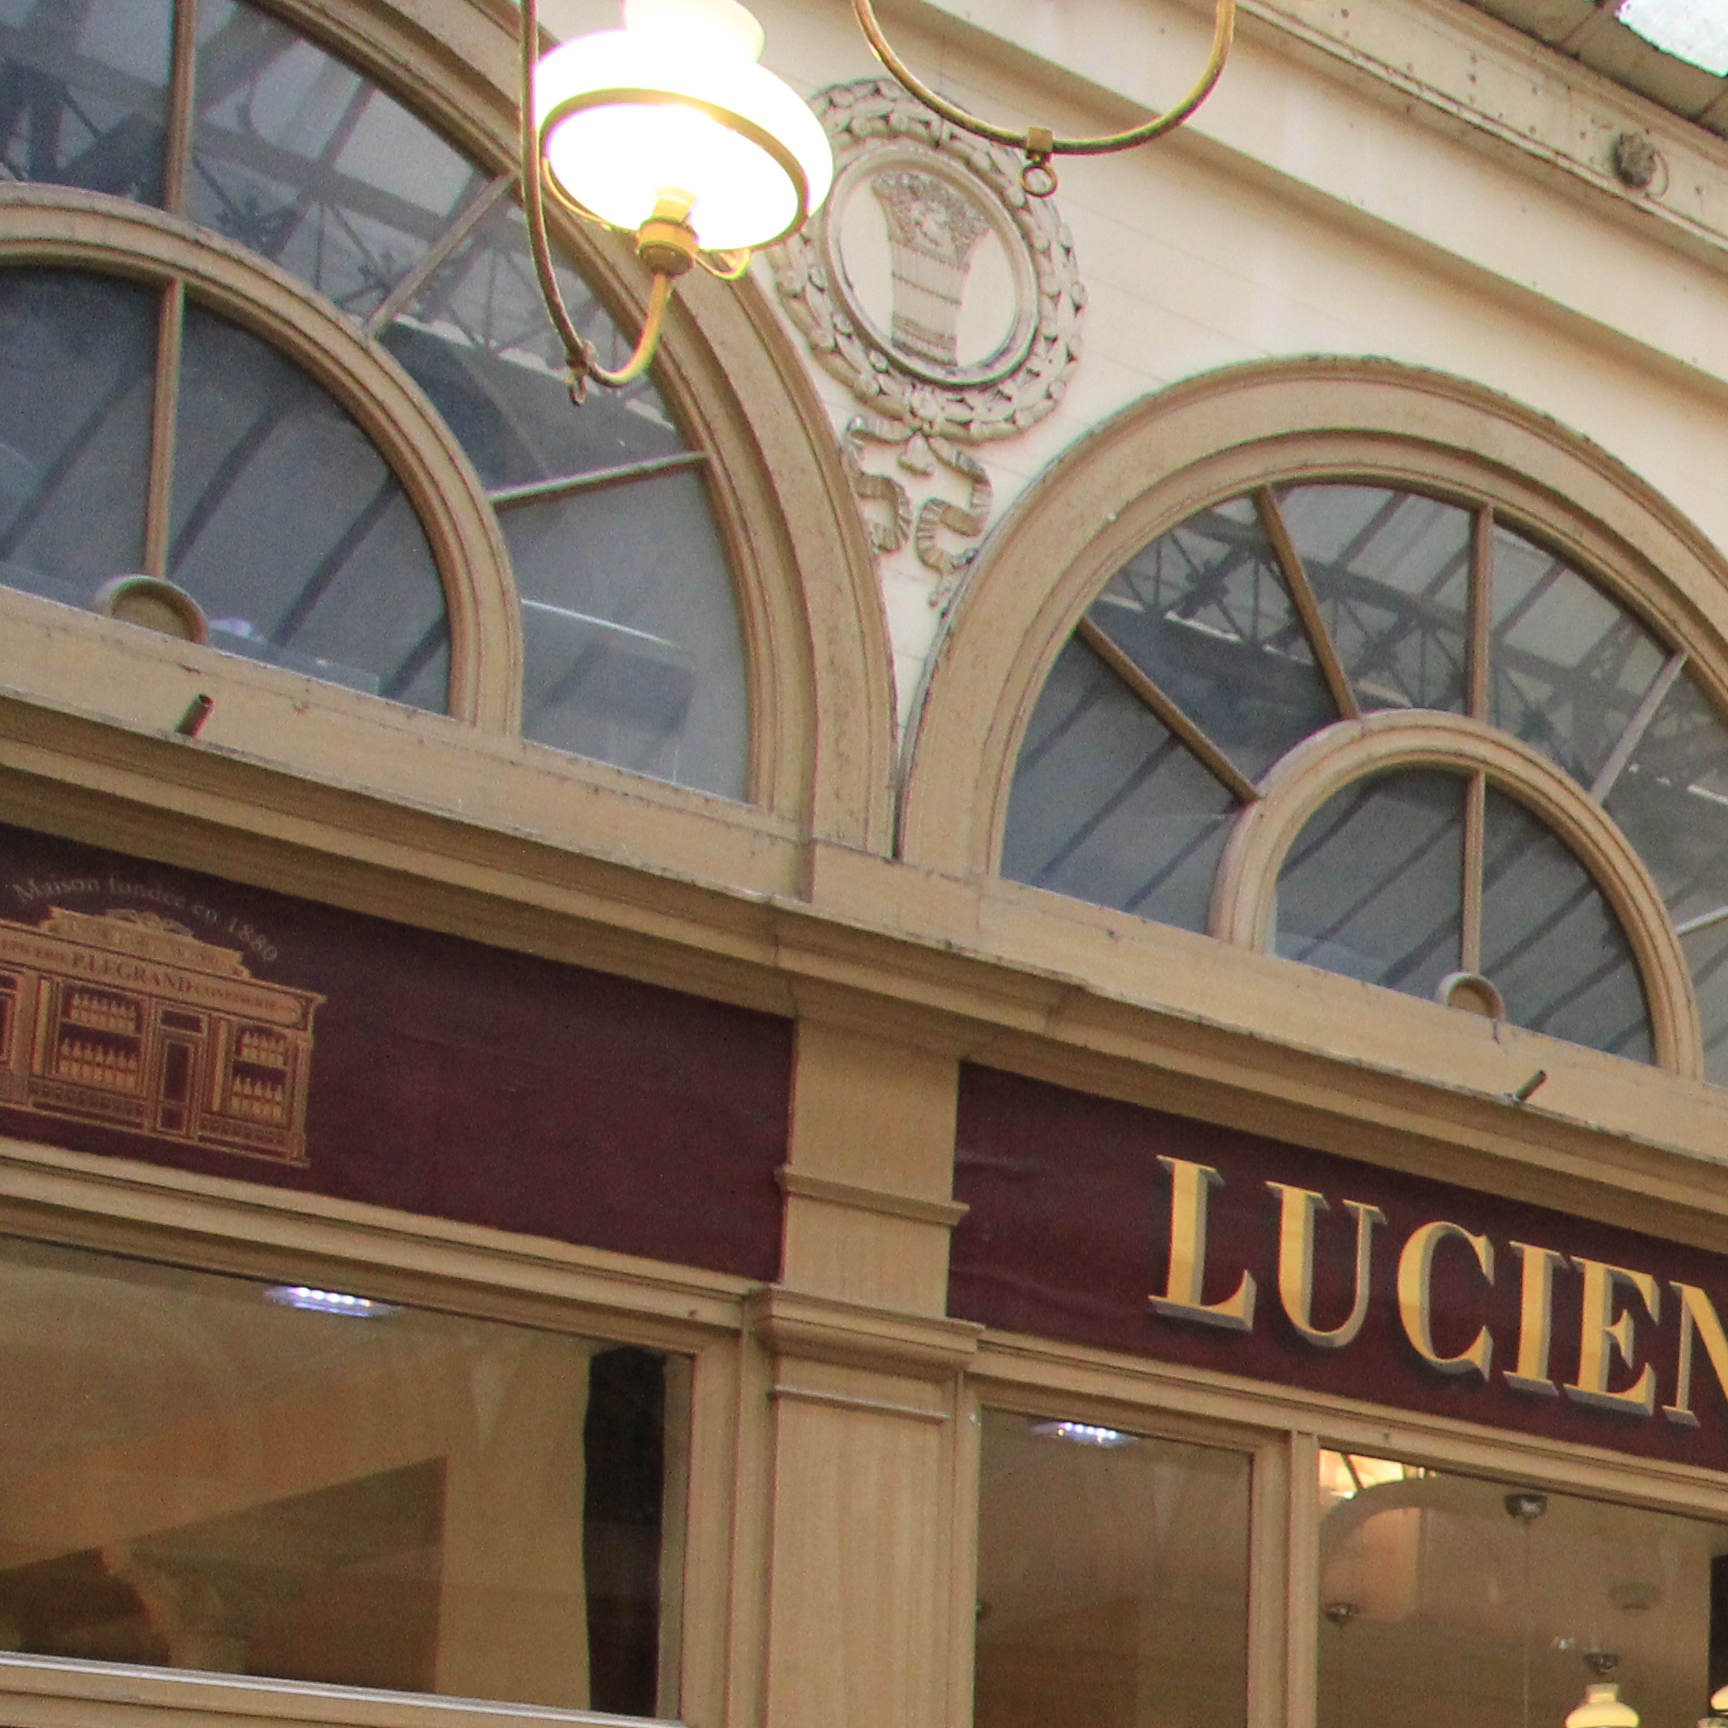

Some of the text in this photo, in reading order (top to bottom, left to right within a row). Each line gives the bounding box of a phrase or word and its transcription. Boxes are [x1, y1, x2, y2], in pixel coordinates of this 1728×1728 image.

[14, 876, 99, 902] Maison
[192, 904, 219, 923] en
[229, 916, 279, 962] 1880
